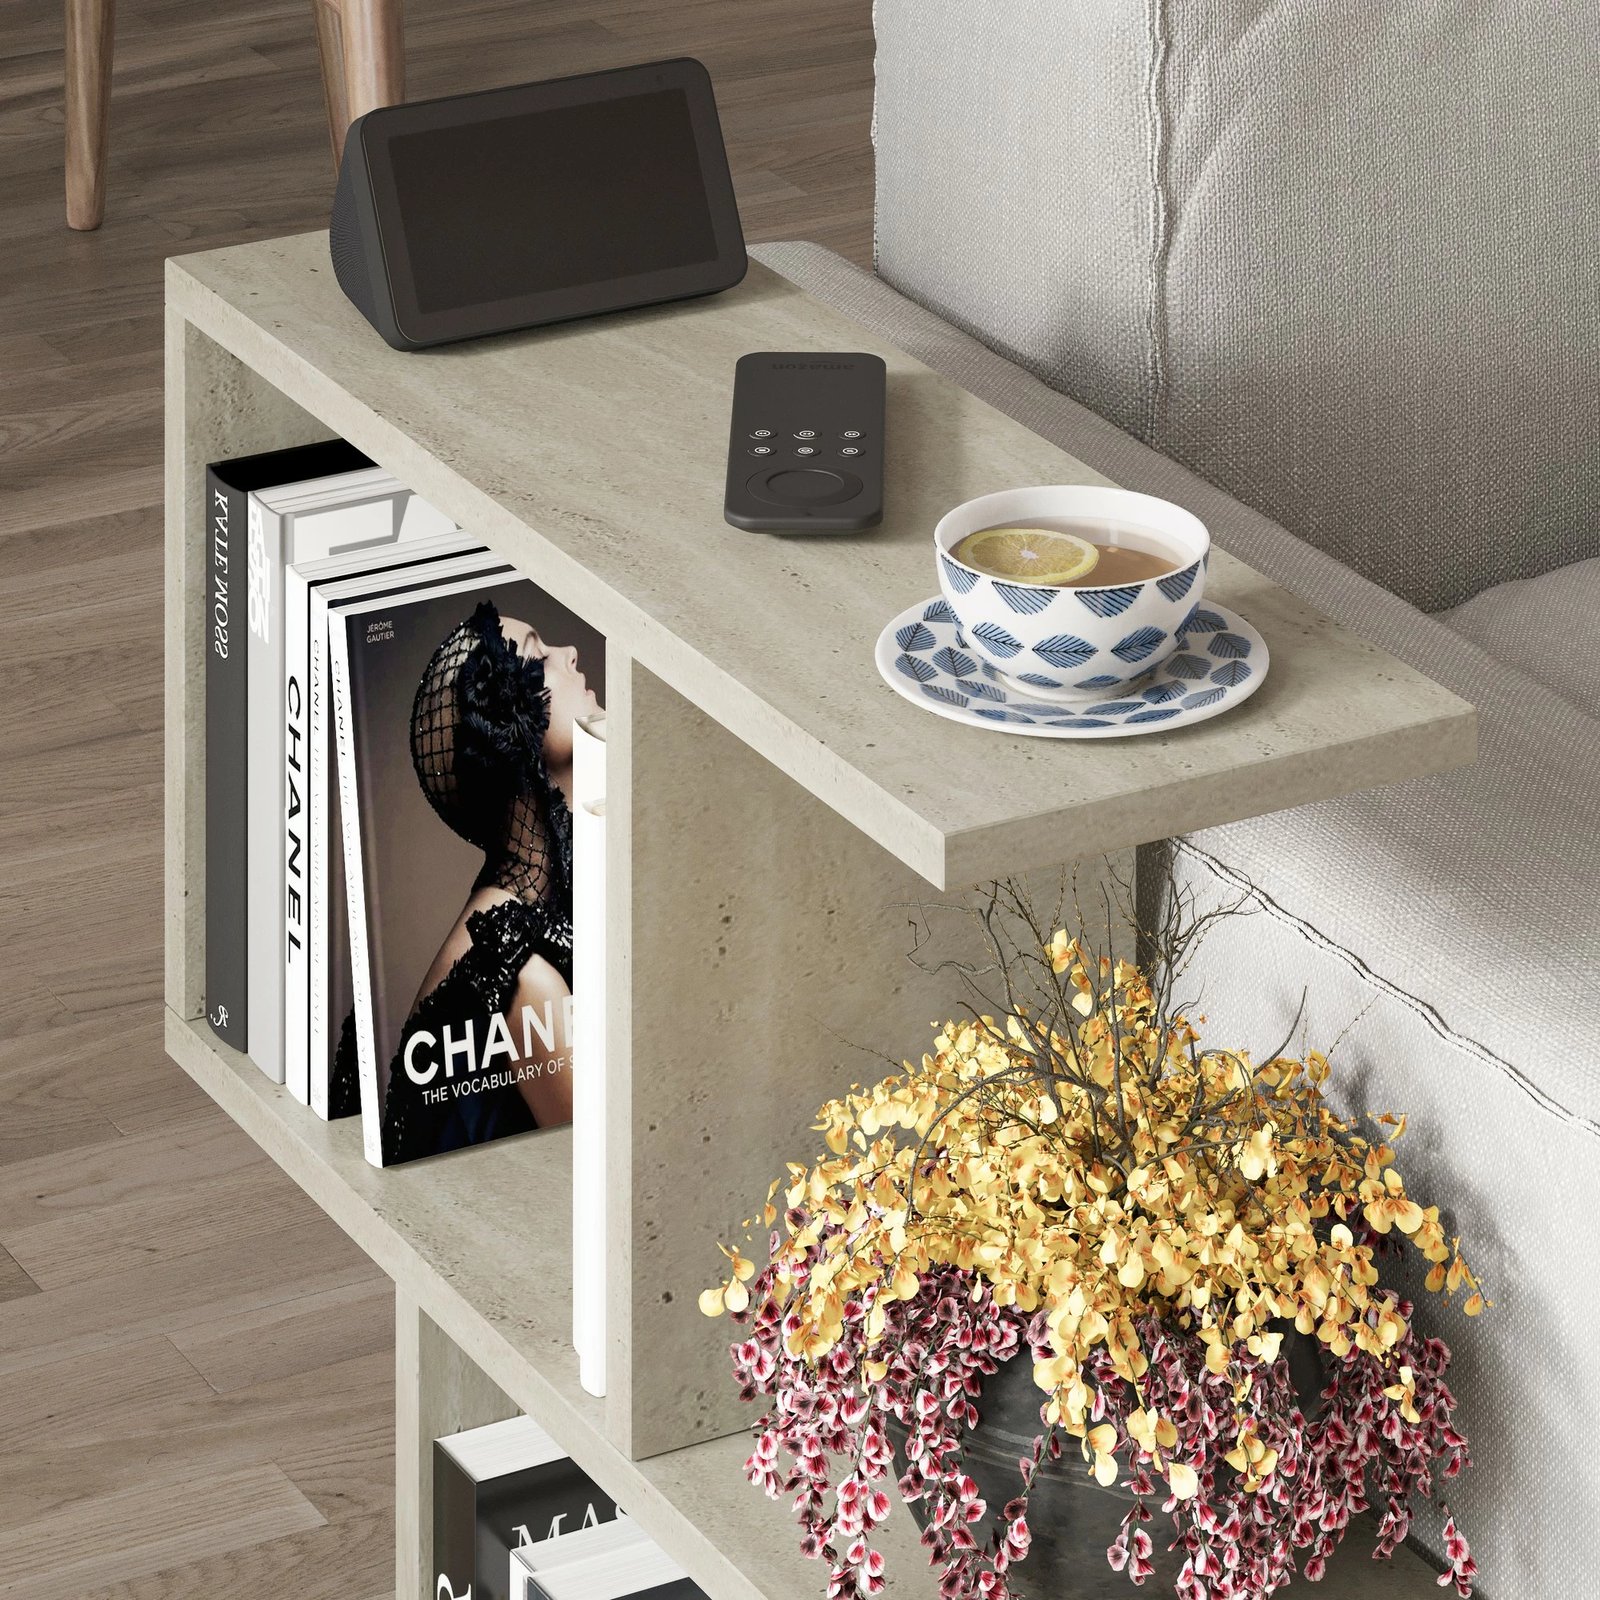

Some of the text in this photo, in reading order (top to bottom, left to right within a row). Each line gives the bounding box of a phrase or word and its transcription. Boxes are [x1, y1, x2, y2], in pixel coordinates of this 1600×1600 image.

[771, 362, 856, 371] amazon
[367, 620, 393, 634] JÉRÔME
[366, 630, 395, 644] GAUTIER
[287, 675, 302, 964] CHANEL
[421, 1086, 448, 1106] THE
[451, 1062, 543, 1096] VOCABULARY
[541, 1057, 566, 1075] OF
